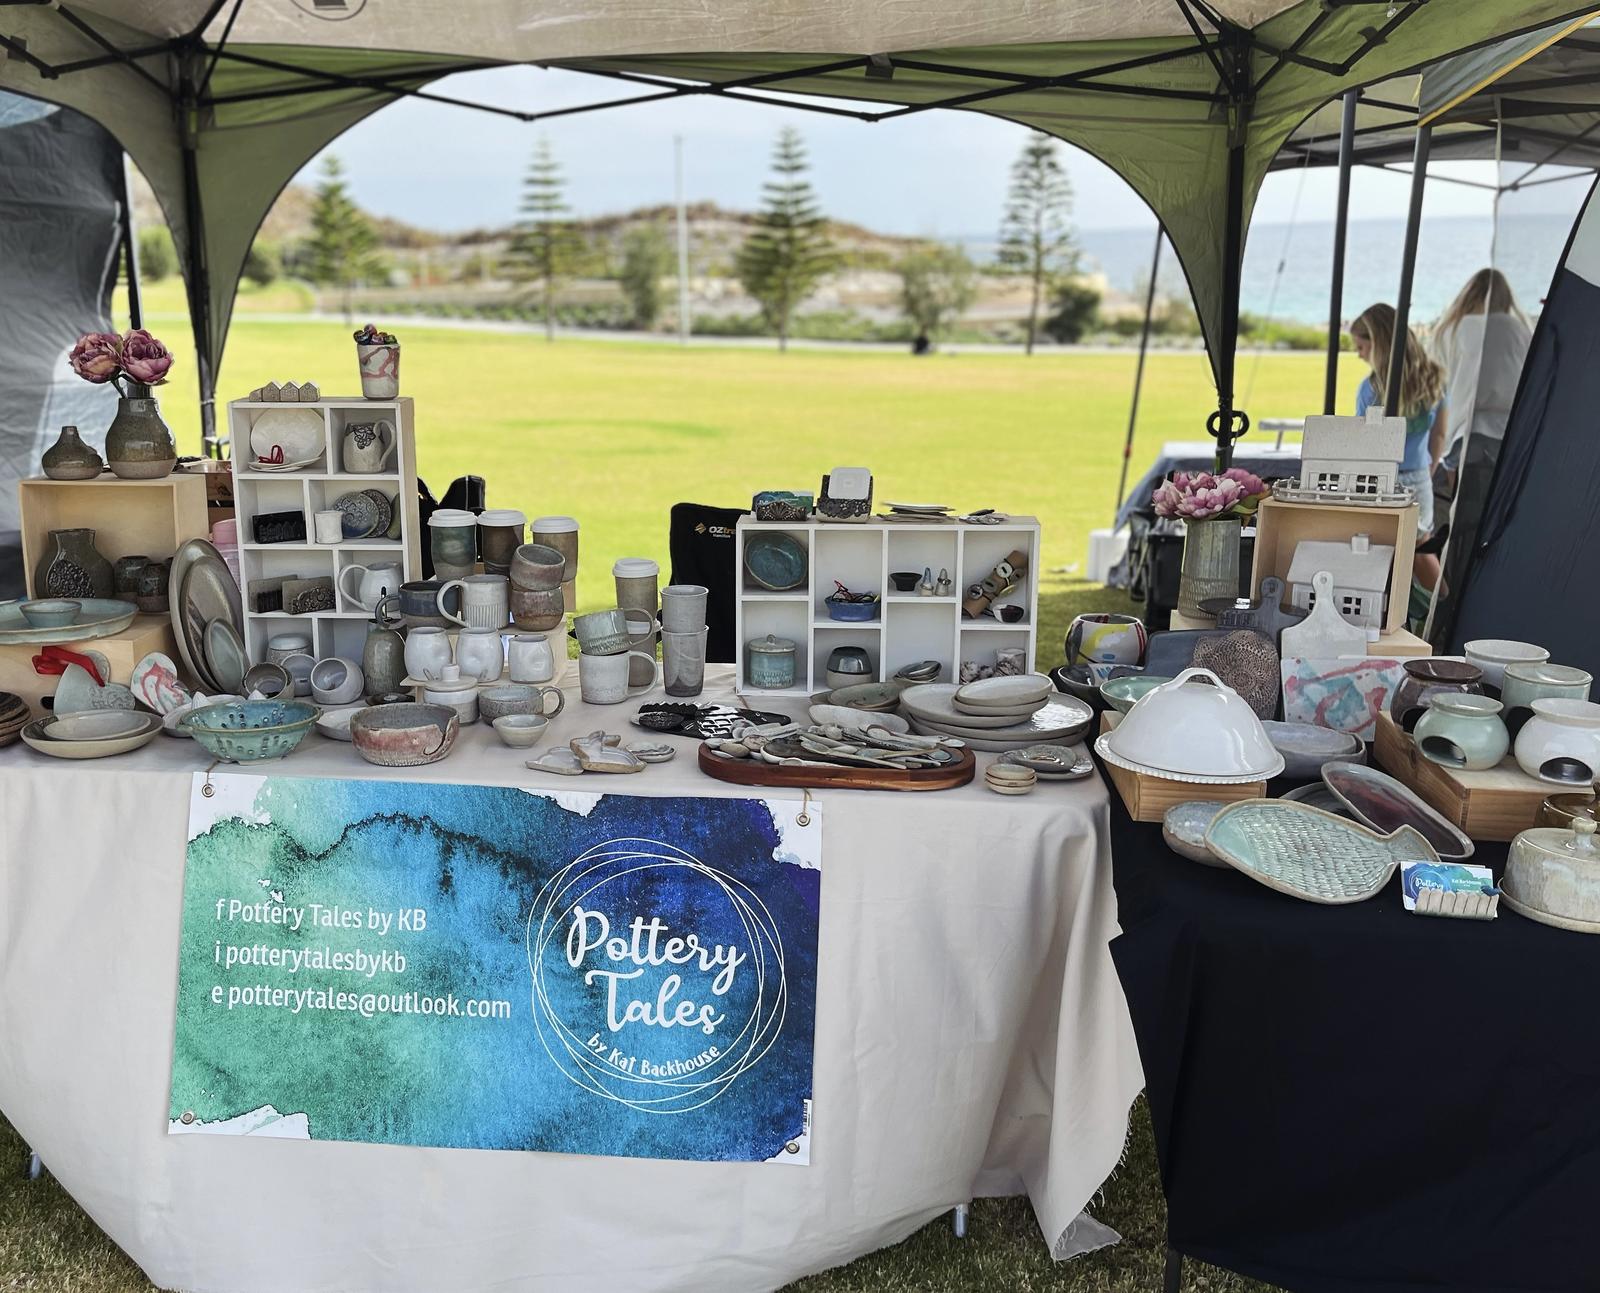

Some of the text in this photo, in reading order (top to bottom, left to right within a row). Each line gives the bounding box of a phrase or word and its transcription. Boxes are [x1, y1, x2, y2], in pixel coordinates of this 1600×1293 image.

[1415, 877, 1444, 890] Pottery
[215, 898, 427, 935] f Pottery Tales by KB
[214, 940, 406, 977] i potterytalesbykb
[566, 905, 747, 996] Pottery
[211, 983, 511, 1019] e potterytales@outlook.com
[585, 968, 726, 1035] Tales
[586, 1032, 721, 1077] by Kat Backhouse
